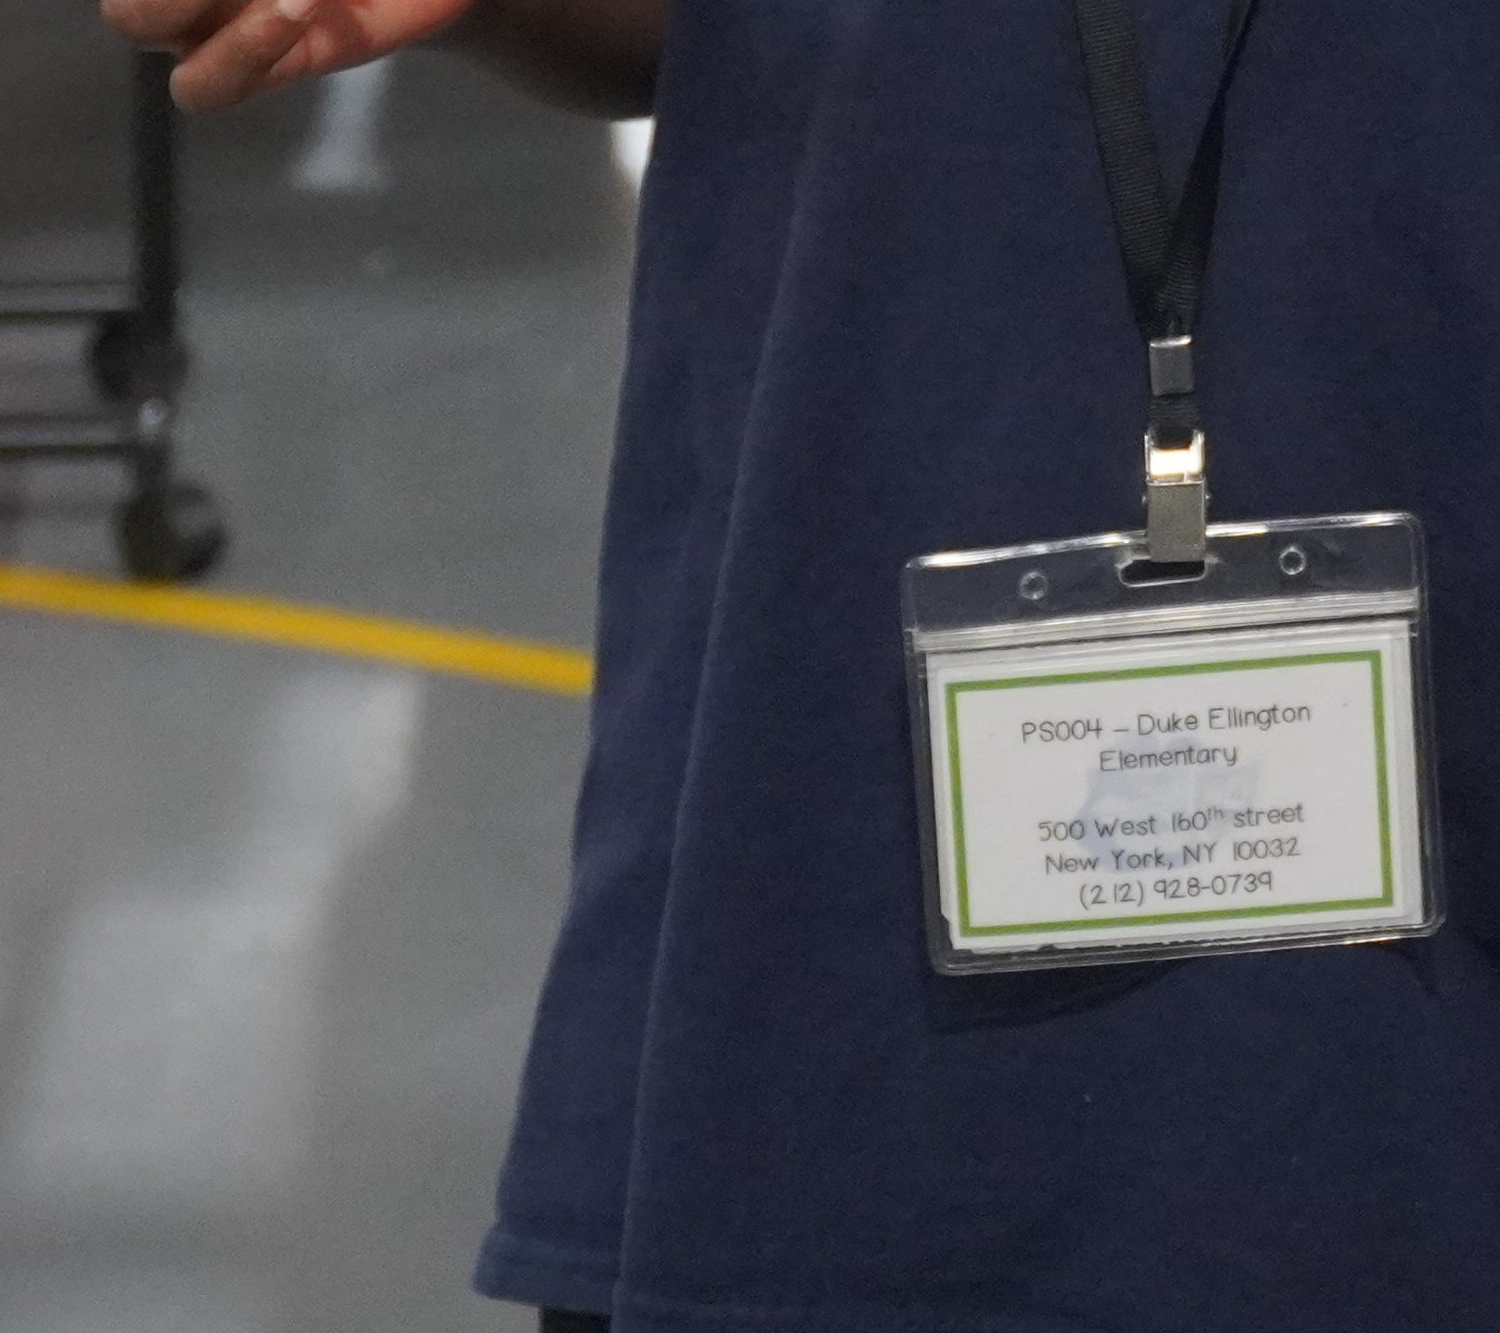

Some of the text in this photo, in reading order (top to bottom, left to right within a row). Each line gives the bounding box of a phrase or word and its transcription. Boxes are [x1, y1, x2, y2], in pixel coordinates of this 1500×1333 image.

[1021, 717, 1103, 744] PS004
[1137, 713, 1199, 736] Duke
[1208, 705, 1311, 732] Ellington
[1099, 745, 1238, 772] Elementary
[1037, 819, 1085, 842] 500
[1094, 817, 1156, 838] West
[1234, 803, 1304, 829] street
[1045, 837, 1301, 875] New York, NY 10032
[1153, 870, 1273, 900] 928-0739
